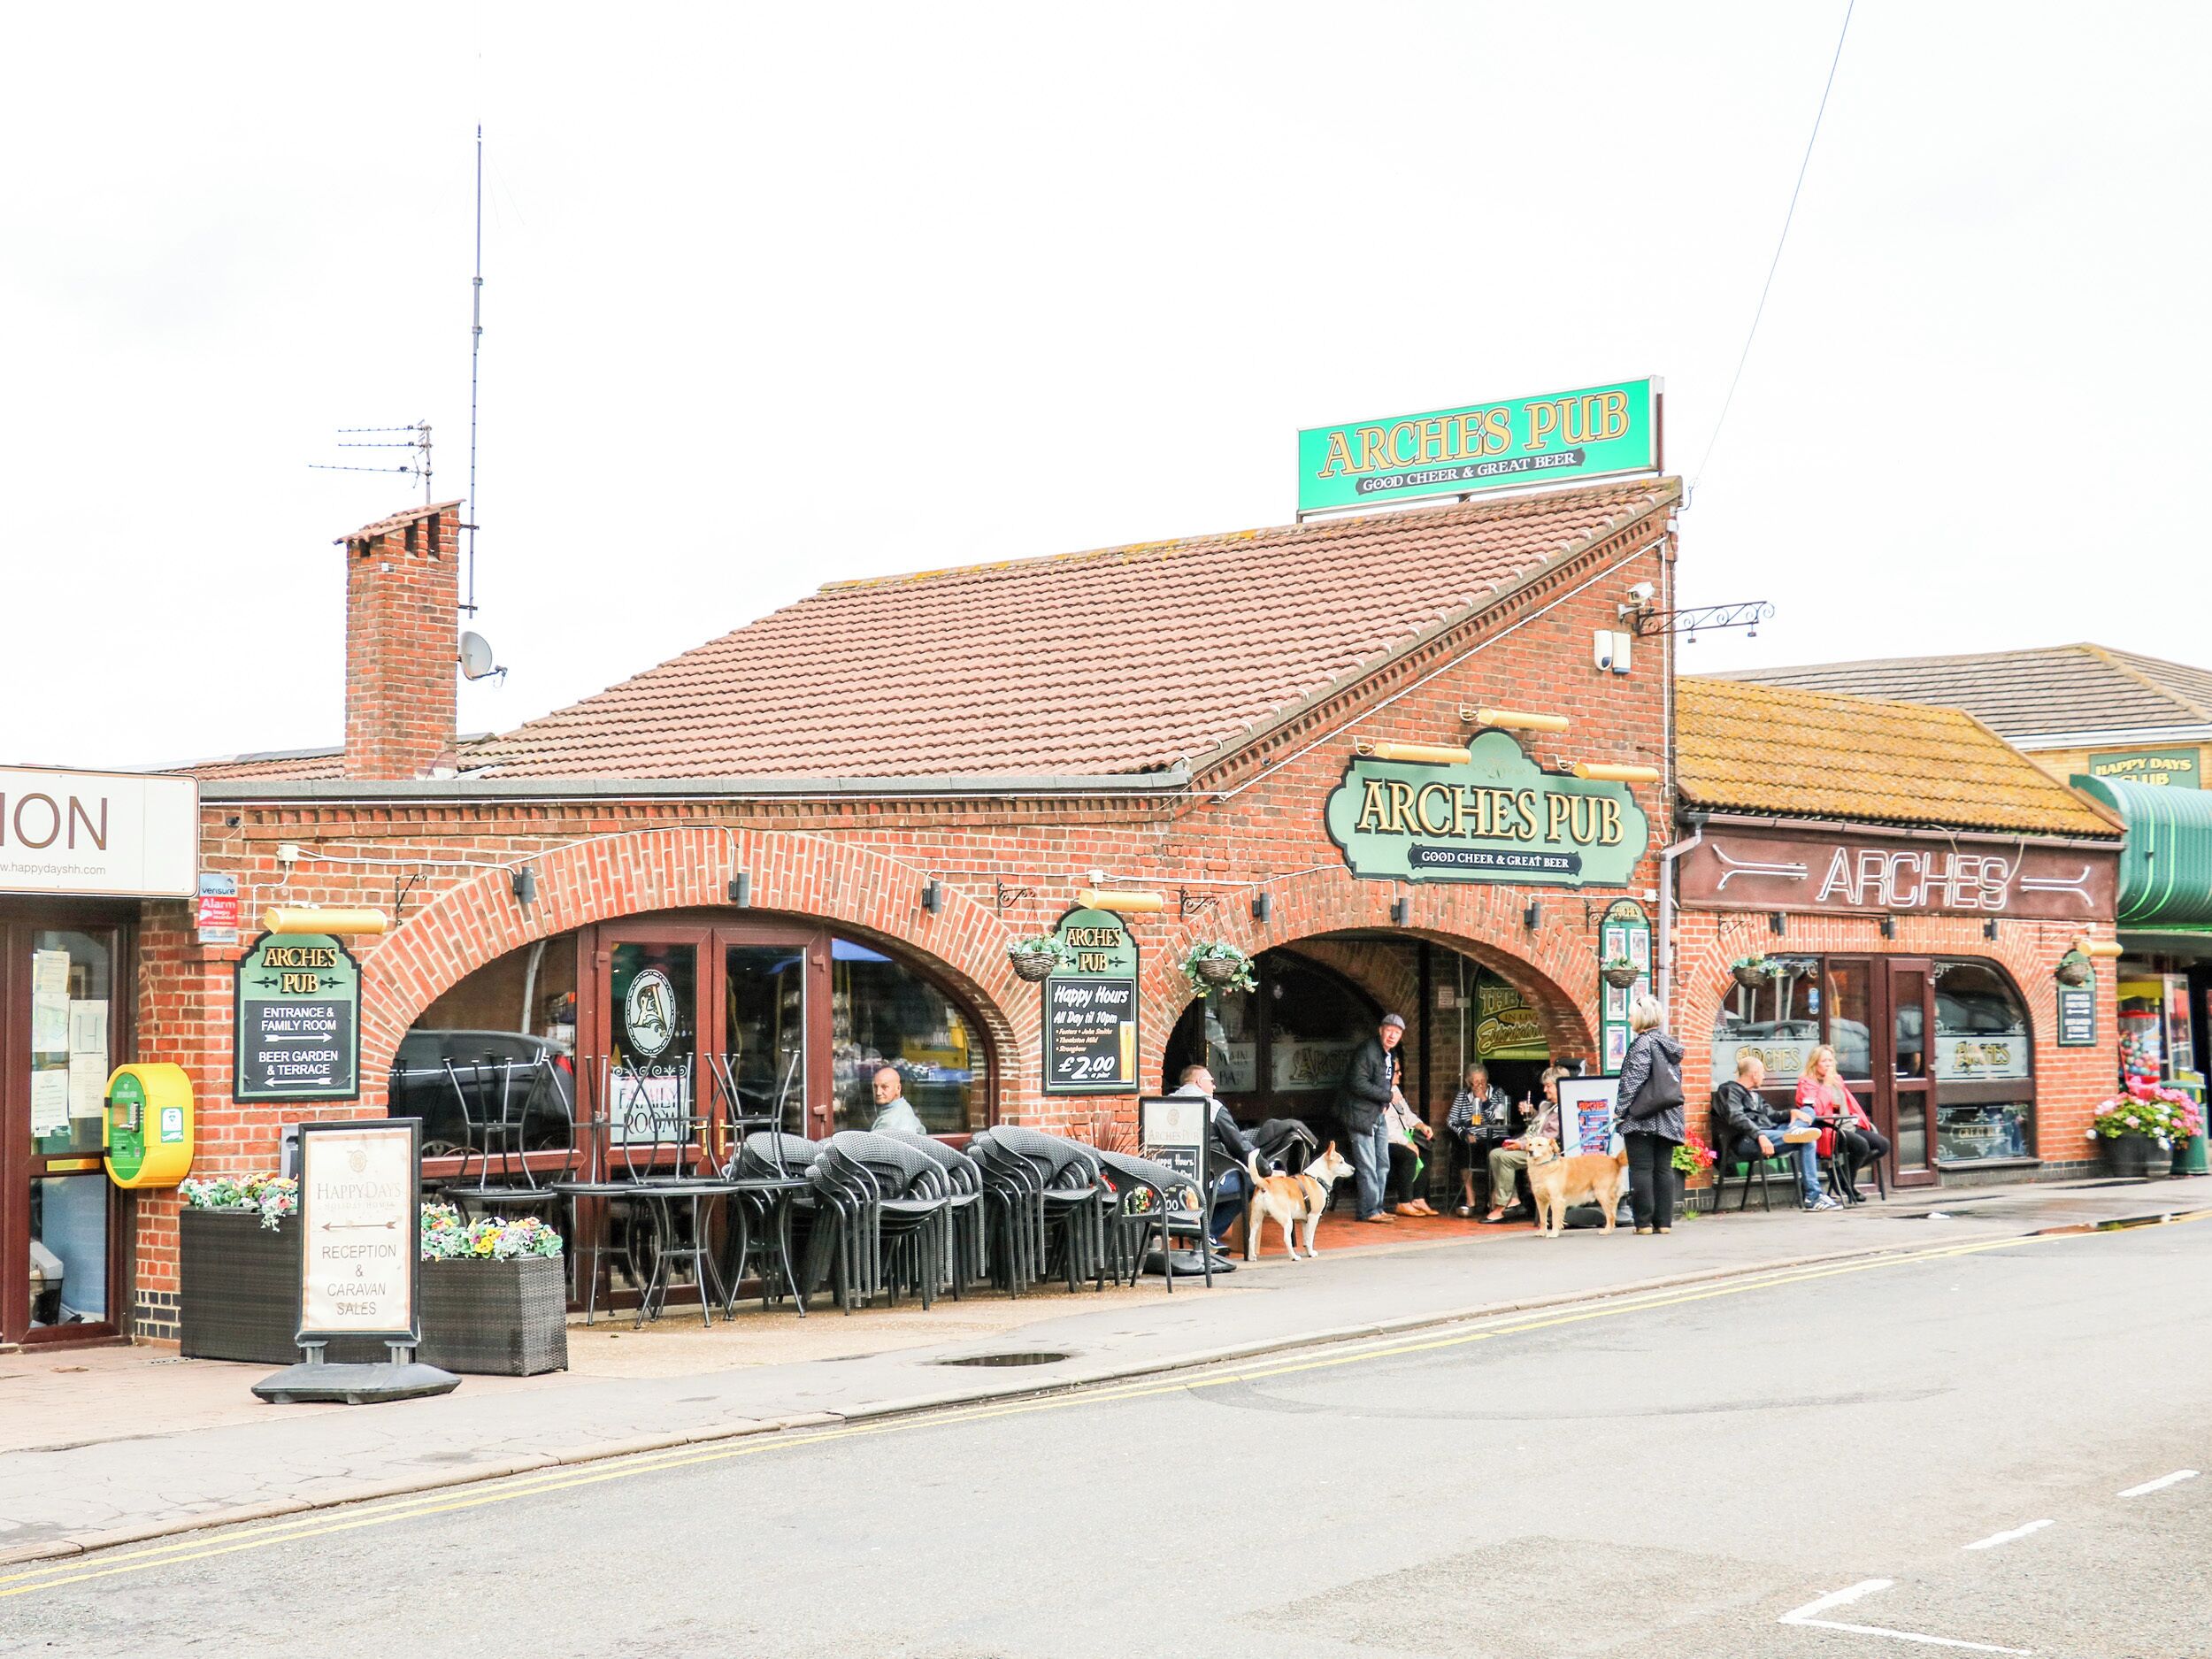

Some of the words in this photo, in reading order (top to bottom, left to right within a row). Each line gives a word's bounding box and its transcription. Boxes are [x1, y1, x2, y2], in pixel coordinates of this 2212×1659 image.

[1318, 407, 1511, 478] ARCHES
[1523, 390, 1629, 451] PUB
[1363, 477, 1404, 492] GOOD
[1406, 469, 1459, 485] CHEER
[1463, 467, 1474, 479] &
[1477, 458, 1532, 476] GREAT
[1534, 452, 1577, 469] BEER
[2095, 757, 2147, 776] HAPPY
[2150, 757, 2193, 772] DAYS
[0, 792, 108, 850] ION
[1356, 780, 1538, 841] ARCHES
[1546, 793, 1624, 844] PUB
[1421, 851, 1455, 863] GOOD
[1457, 853, 1494, 864] CHEER
[1496, 855, 1505, 864] &
[1507, 855, 1541, 867] GREAT
[1543, 857, 1569, 868] BEER
[1815, 847, 2008, 910] ARCHES
[202, 898, 235, 909] Alarm
[1065, 927, 1122, 947] ARCHES
[263, 948, 338, 967] ARCHES
[1079, 952, 1109, 972] PUB
[281, 973, 319, 993] PUB
[1053, 984, 1094, 1008] Happy
[1094, 985, 1130, 1004] Hours
[263, 1007, 325, 1018] ENTRANCE
[326, 1007, 334, 1017] &
[1053, 1010, 1067, 1024] All
[1067, 1010, 1084, 1026] Day
[1096, 1010, 1118, 1026] 10pm
[261, 1020, 300, 1032] FAMILY
[303, 1019, 336, 1031] ROOM
[258, 1051, 289, 1063] BEER
[292, 1050, 338, 1062] GARDEN
[267, 1065, 275, 1075] &
[277, 1064, 330, 1075] TERRACE
[1058, 1056, 1116, 1079] £2.00
[322, 1244, 396, 1259] RECEPTION
[355, 1263, 364, 1278] &
[327, 1282, 386, 1296] CARAVAN
[336, 1302, 377, 1316] SALES
